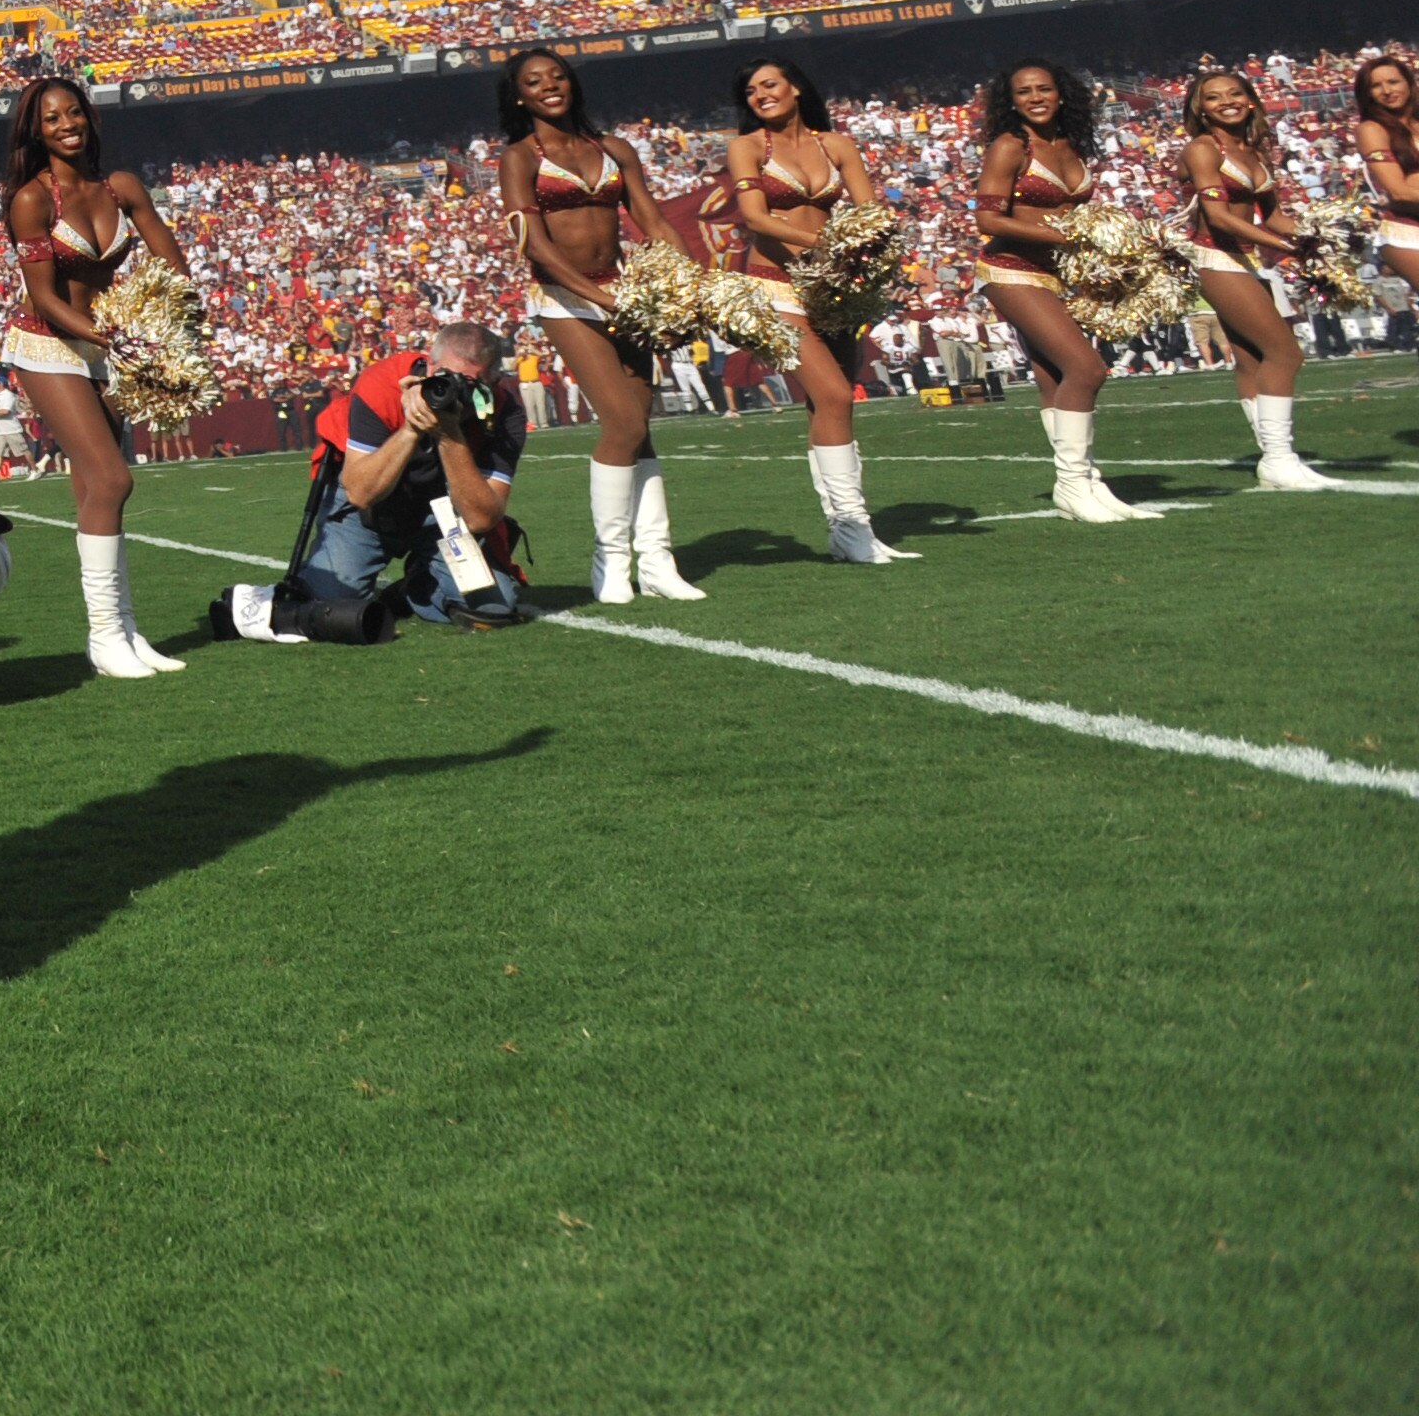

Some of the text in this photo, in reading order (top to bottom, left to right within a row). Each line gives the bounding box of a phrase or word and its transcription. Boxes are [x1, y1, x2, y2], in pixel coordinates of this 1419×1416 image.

[823, 2, 954, 28] REDSKINS LEGACY
[580, 38, 625, 54] Legacy
[331, 64, 395, 79] VALOTTERY.COM
[165, 82, 200, 97] Every
[203, 79, 225, 93] Day
[243, 74, 280, 88] Game
[283, 70, 307, 86] Day
